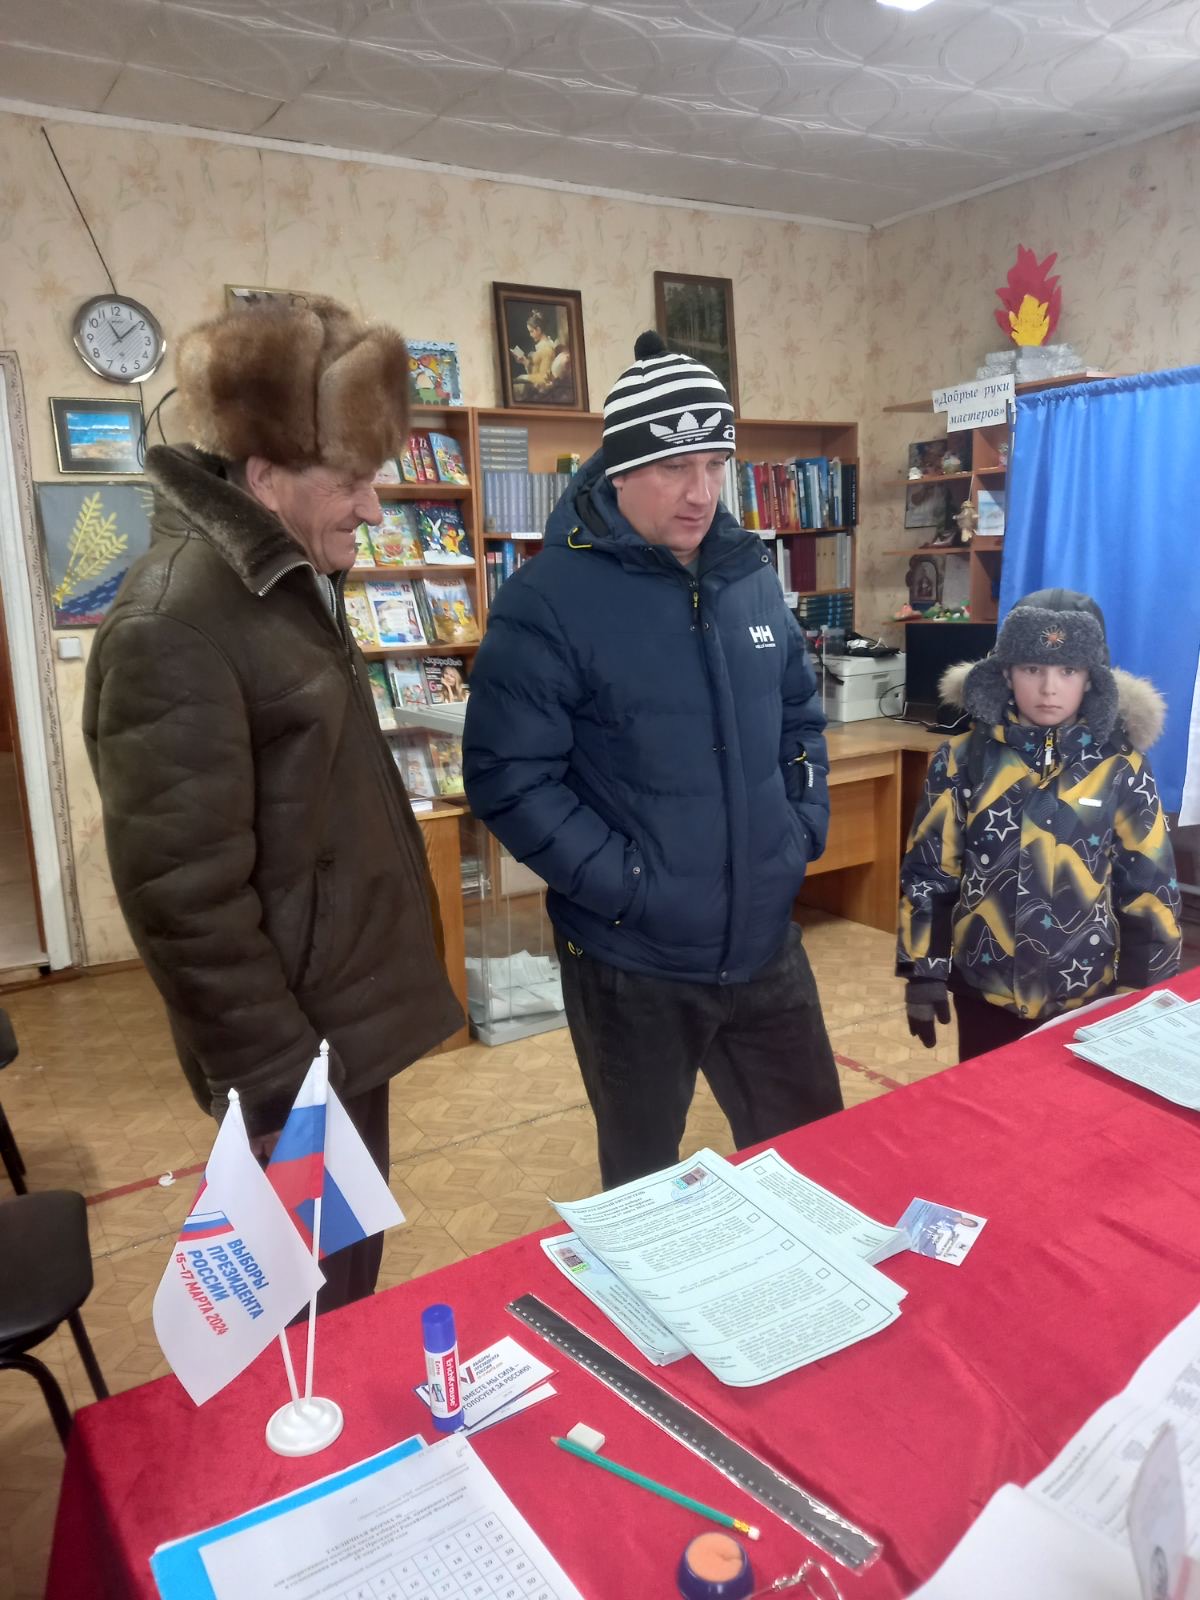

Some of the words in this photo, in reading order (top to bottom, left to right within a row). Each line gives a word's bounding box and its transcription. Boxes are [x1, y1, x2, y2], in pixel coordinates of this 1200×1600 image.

[98, 310, 105, 319] 11
[111, 306, 120, 317] 12
[129, 311, 133, 320] 1
[89, 318, 99, 328] 10
[139, 320, 146, 331] 2
[86, 333, 94, 343] 9
[144, 336, 152, 346] 3
[92, 347, 100, 358] 8
[142, 350, 149, 359] 4
[106, 359, 113, 369] 7
[120, 363, 127, 373] 6
[133, 360, 140, 370] 5
[984, 382, 1010, 398] руки
[748, 625, 775, 643] HH
[227, 1238, 269, 1290] ВЫБОРЫ
[187, 1249, 230, 1302] РОССИИ
[206, 1245, 265, 1320] ПРЕЗИДЕНТА
[185, 1280, 215, 1315] МАРТА
[206, 1313, 230, 1336] 2024
[462, 1383, 488, 1402] ВМЕСТЕ
[486, 1376, 499, 1387] МЫ
[497, 1366, 515, 1379] СИЛА
[495, 1382, 504, 1390] ЗА
[484, 1520, 494, 1528] 10
[474, 1545, 483, 1553] 19
[483, 1560, 493, 1568] 29
[432, 1568, 440, 1576] 17
